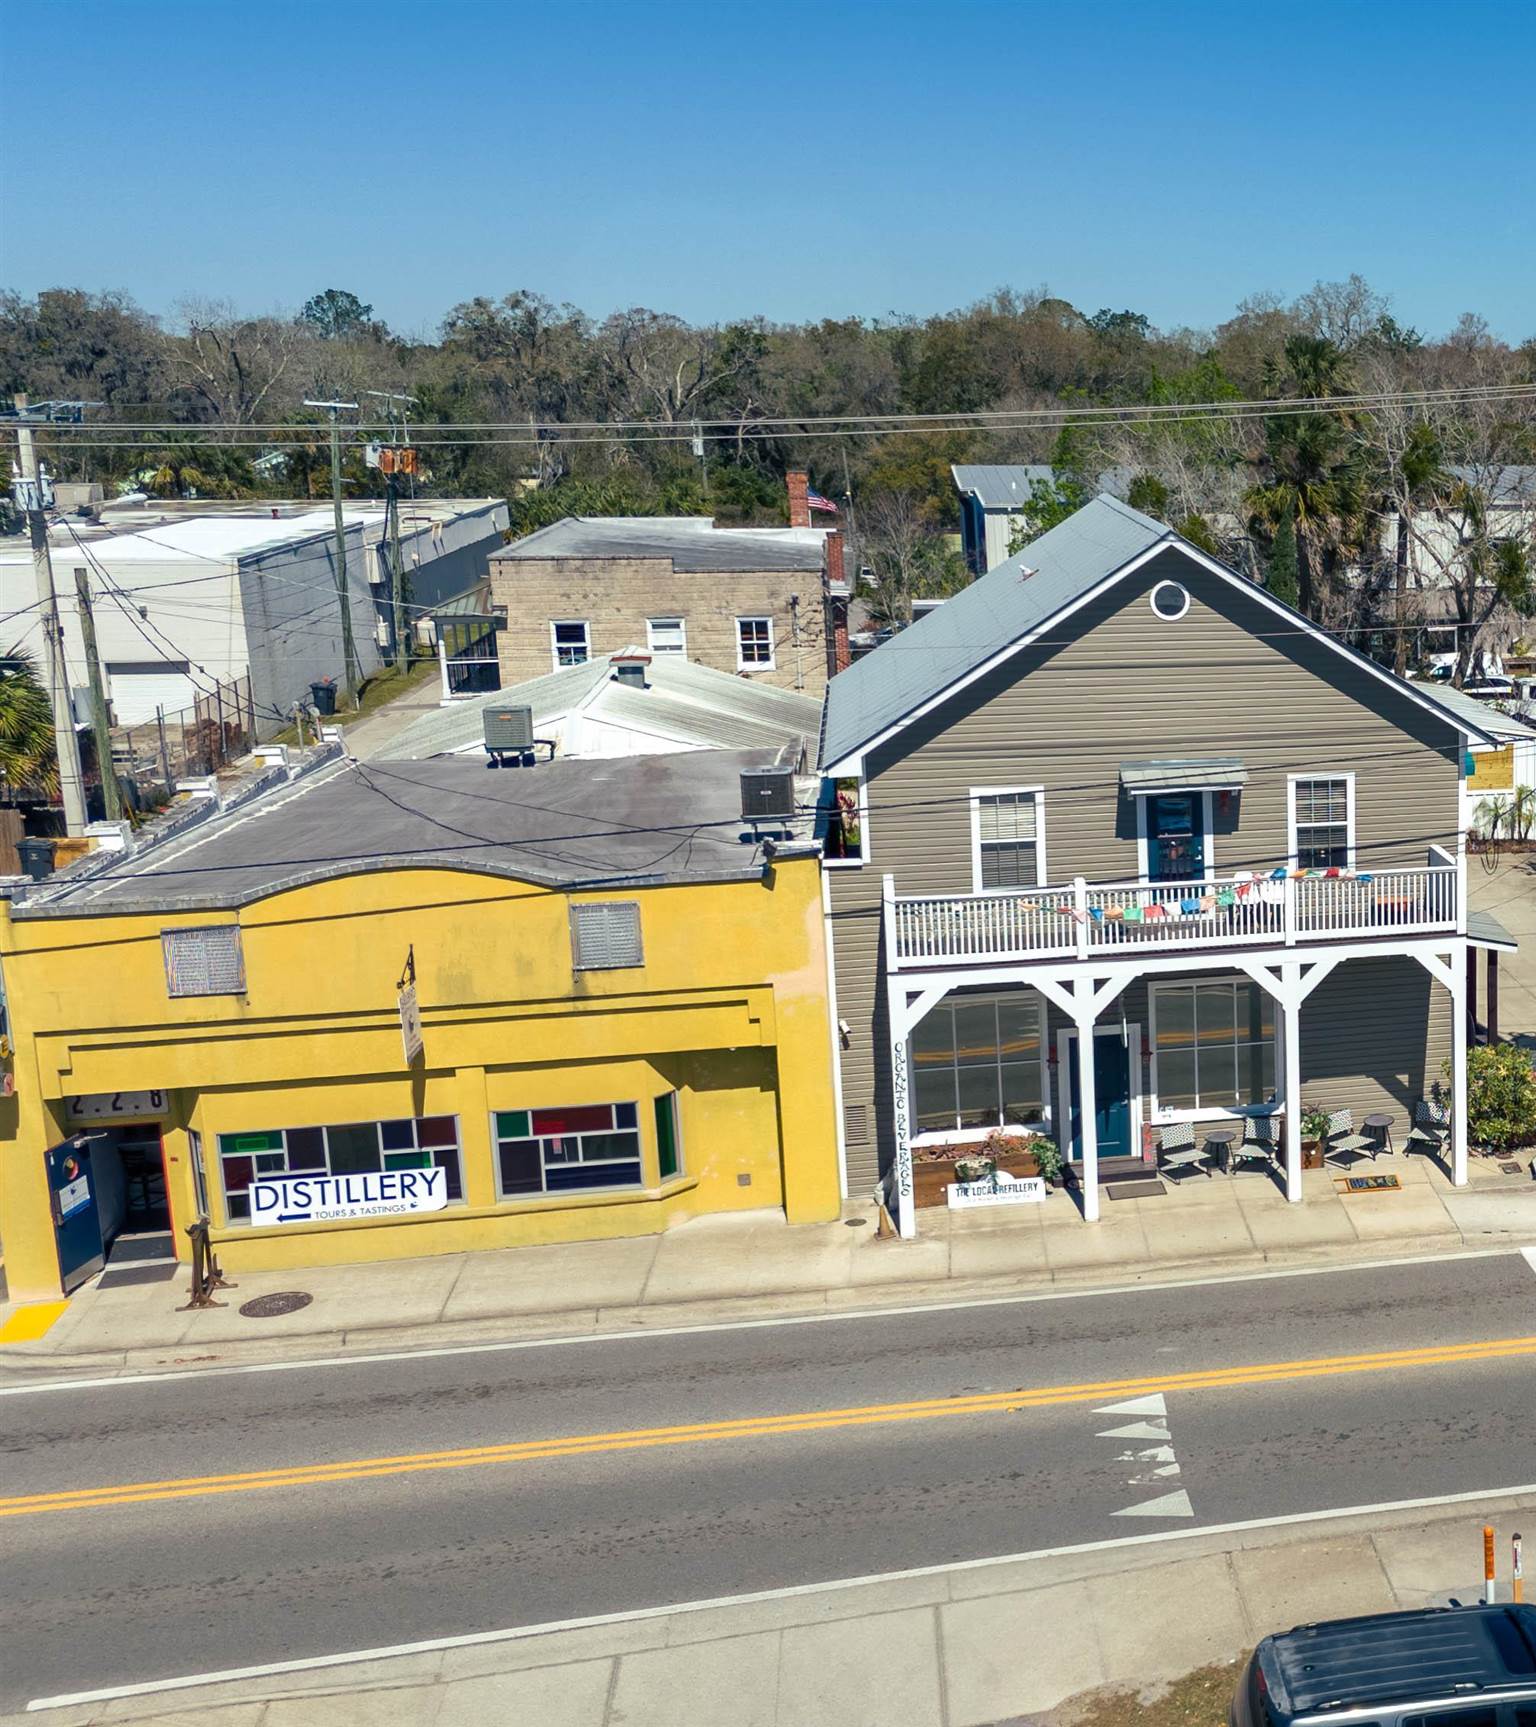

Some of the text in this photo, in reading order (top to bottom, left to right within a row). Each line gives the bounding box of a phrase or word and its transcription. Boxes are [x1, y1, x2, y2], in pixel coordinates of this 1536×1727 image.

[254, 1170, 440, 1212] DISTILLERY
[999, 1181, 1038, 1195] REFILLERY
[315, 1204, 407, 1219] TOURS & TASTINGS
